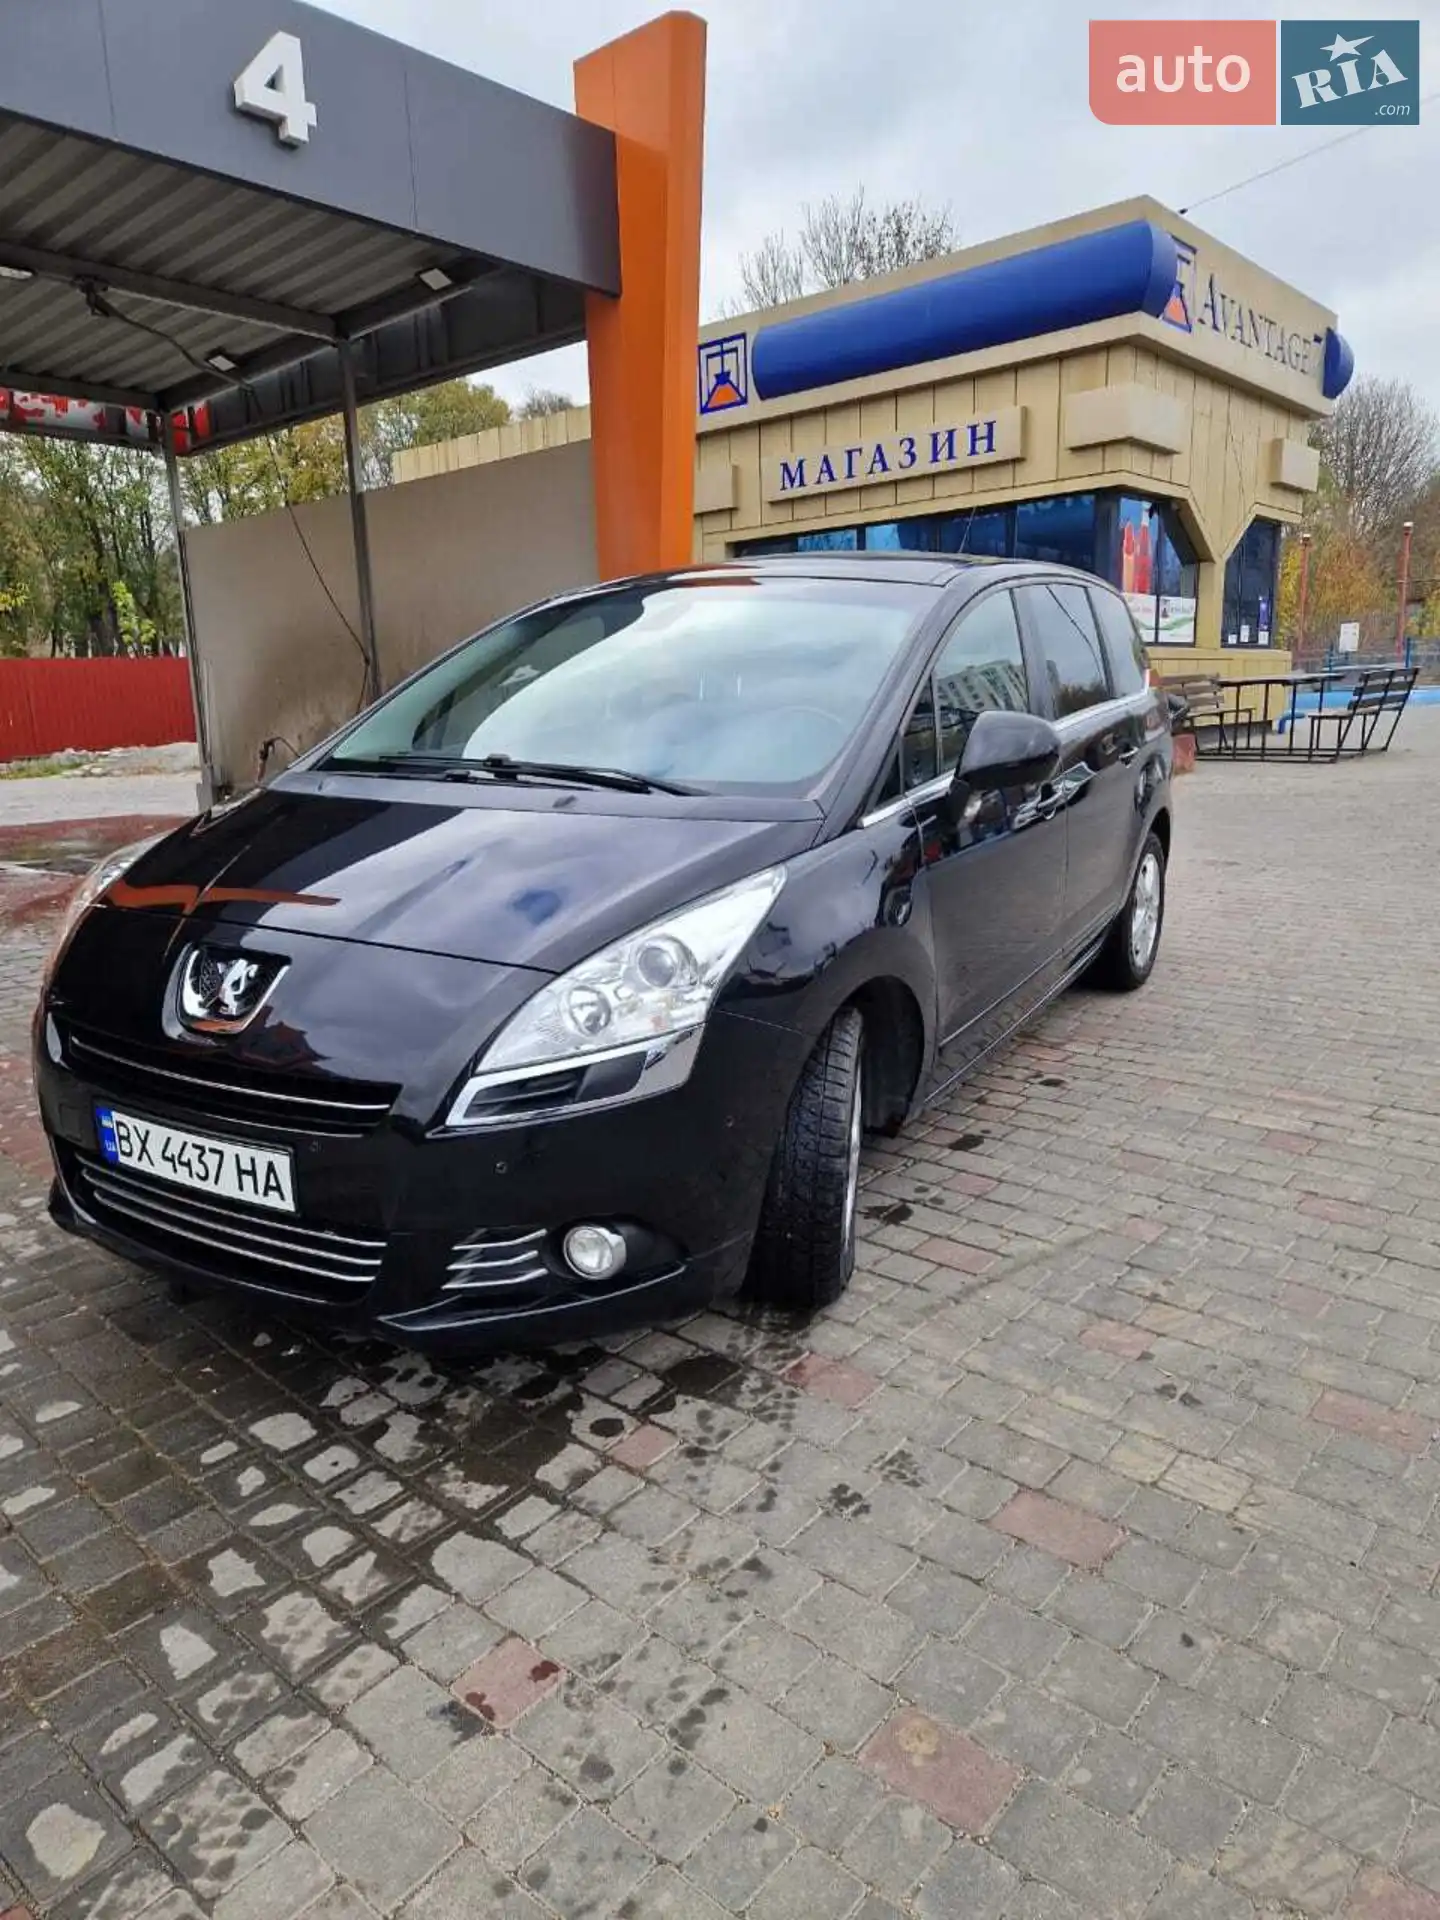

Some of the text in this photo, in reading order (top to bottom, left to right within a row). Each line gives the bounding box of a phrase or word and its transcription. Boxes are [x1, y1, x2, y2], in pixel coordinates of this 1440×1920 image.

[233, 30, 318, 147] 4
[779, 420, 998, 492] МАГАЗИН
[161, 1136, 225, 1186] 4437
